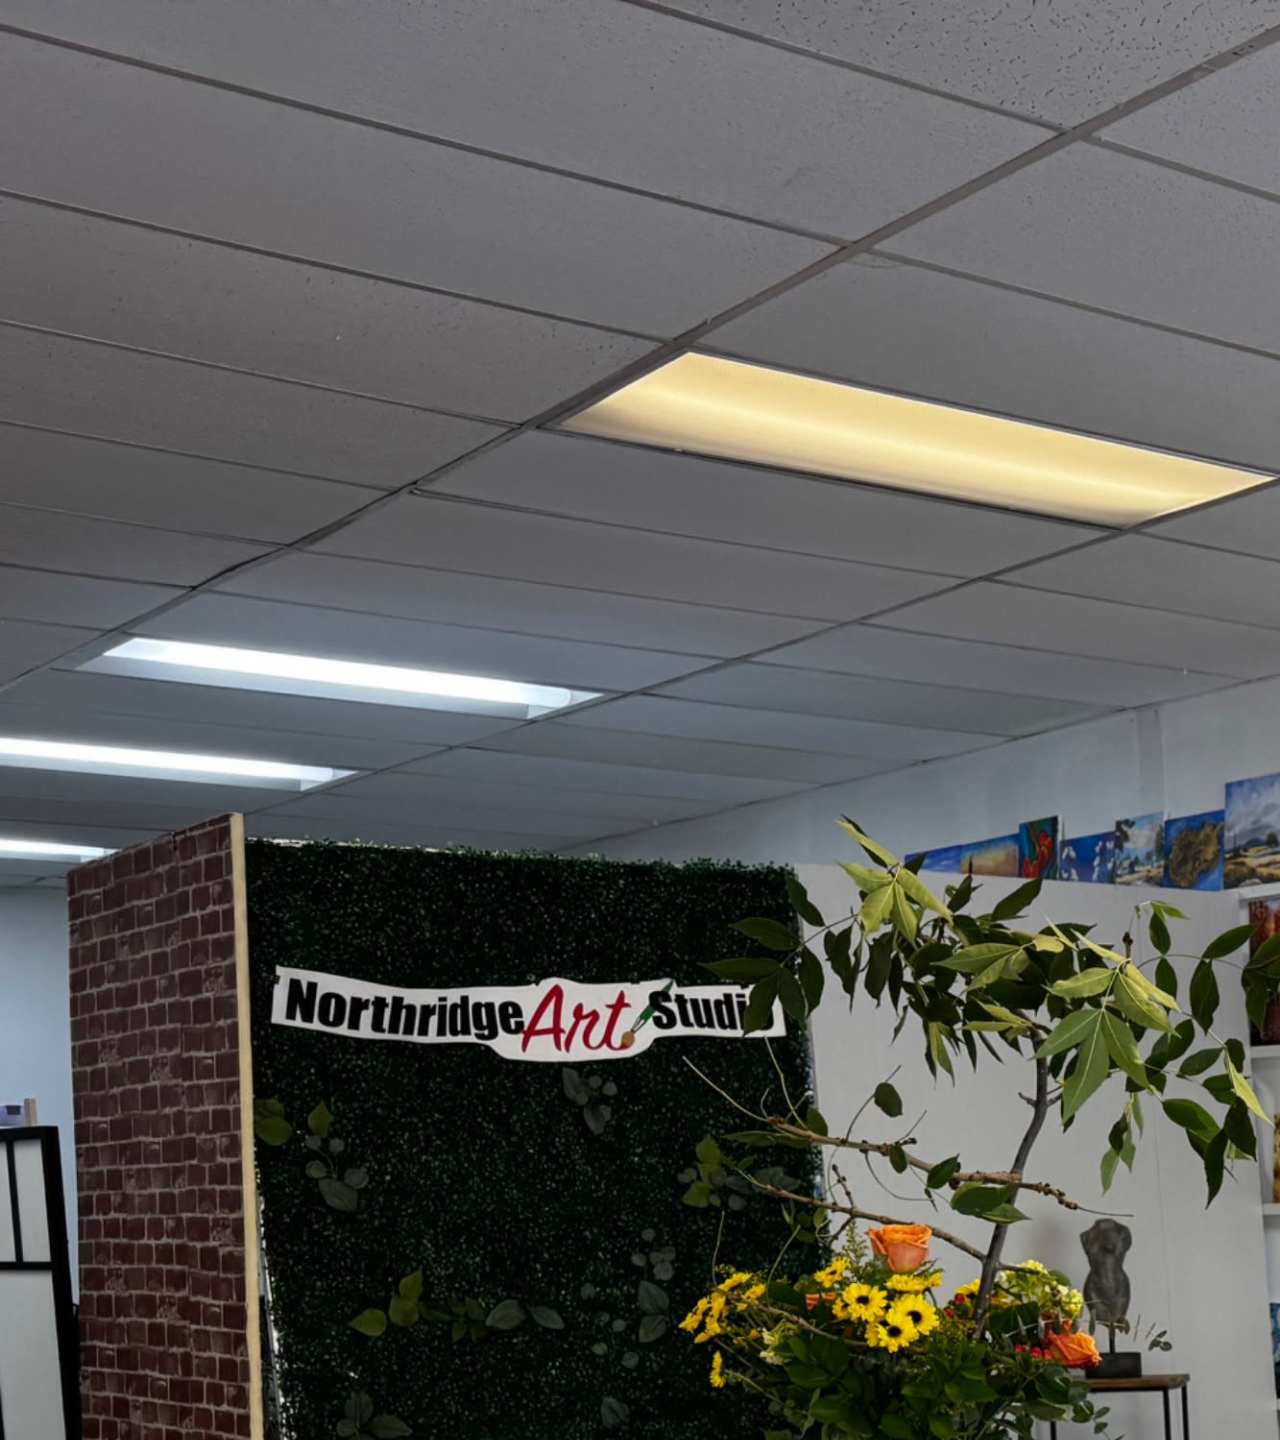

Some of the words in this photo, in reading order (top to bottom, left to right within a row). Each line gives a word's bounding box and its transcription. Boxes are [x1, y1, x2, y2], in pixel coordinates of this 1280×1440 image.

[285, 977, 525, 1041] Northridge
[521, 984, 632, 1053] Art
[648, 990, 775, 1031] Studi
